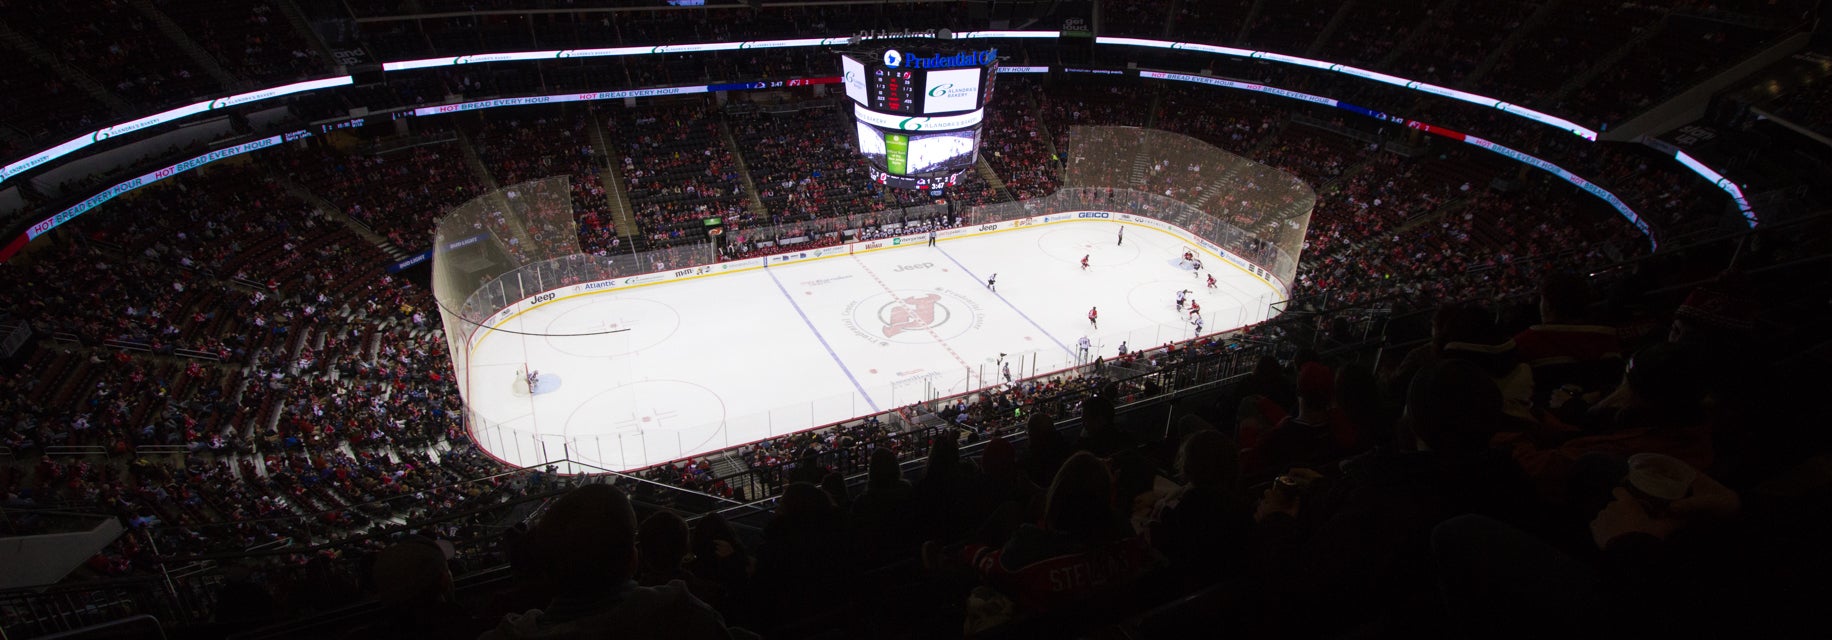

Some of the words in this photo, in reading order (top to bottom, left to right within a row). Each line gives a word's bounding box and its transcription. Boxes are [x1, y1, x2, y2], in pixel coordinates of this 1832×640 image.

[905, 52, 976, 68] Prudential
[461, 101, 491, 110] BREAD
[494, 98, 525, 106] EVERY
[155, 167, 174, 180] HOT
[177, 156, 207, 172] BREAD
[208, 145, 242, 161] EVERY
[244, 138, 272, 150] HOUR
[34, 218, 55, 235] HOT
[56, 202, 86, 224] BREAD
[86, 190, 112, 210] EVERY
[114, 178, 142, 195] HOUR
[462, 237, 477, 246] LIGHT
[410, 254, 425, 265] LIGHT
[894, 262, 934, 273] Jeep
[585, 280, 616, 290] Atlantic
[531, 292, 556, 305] Jeep
